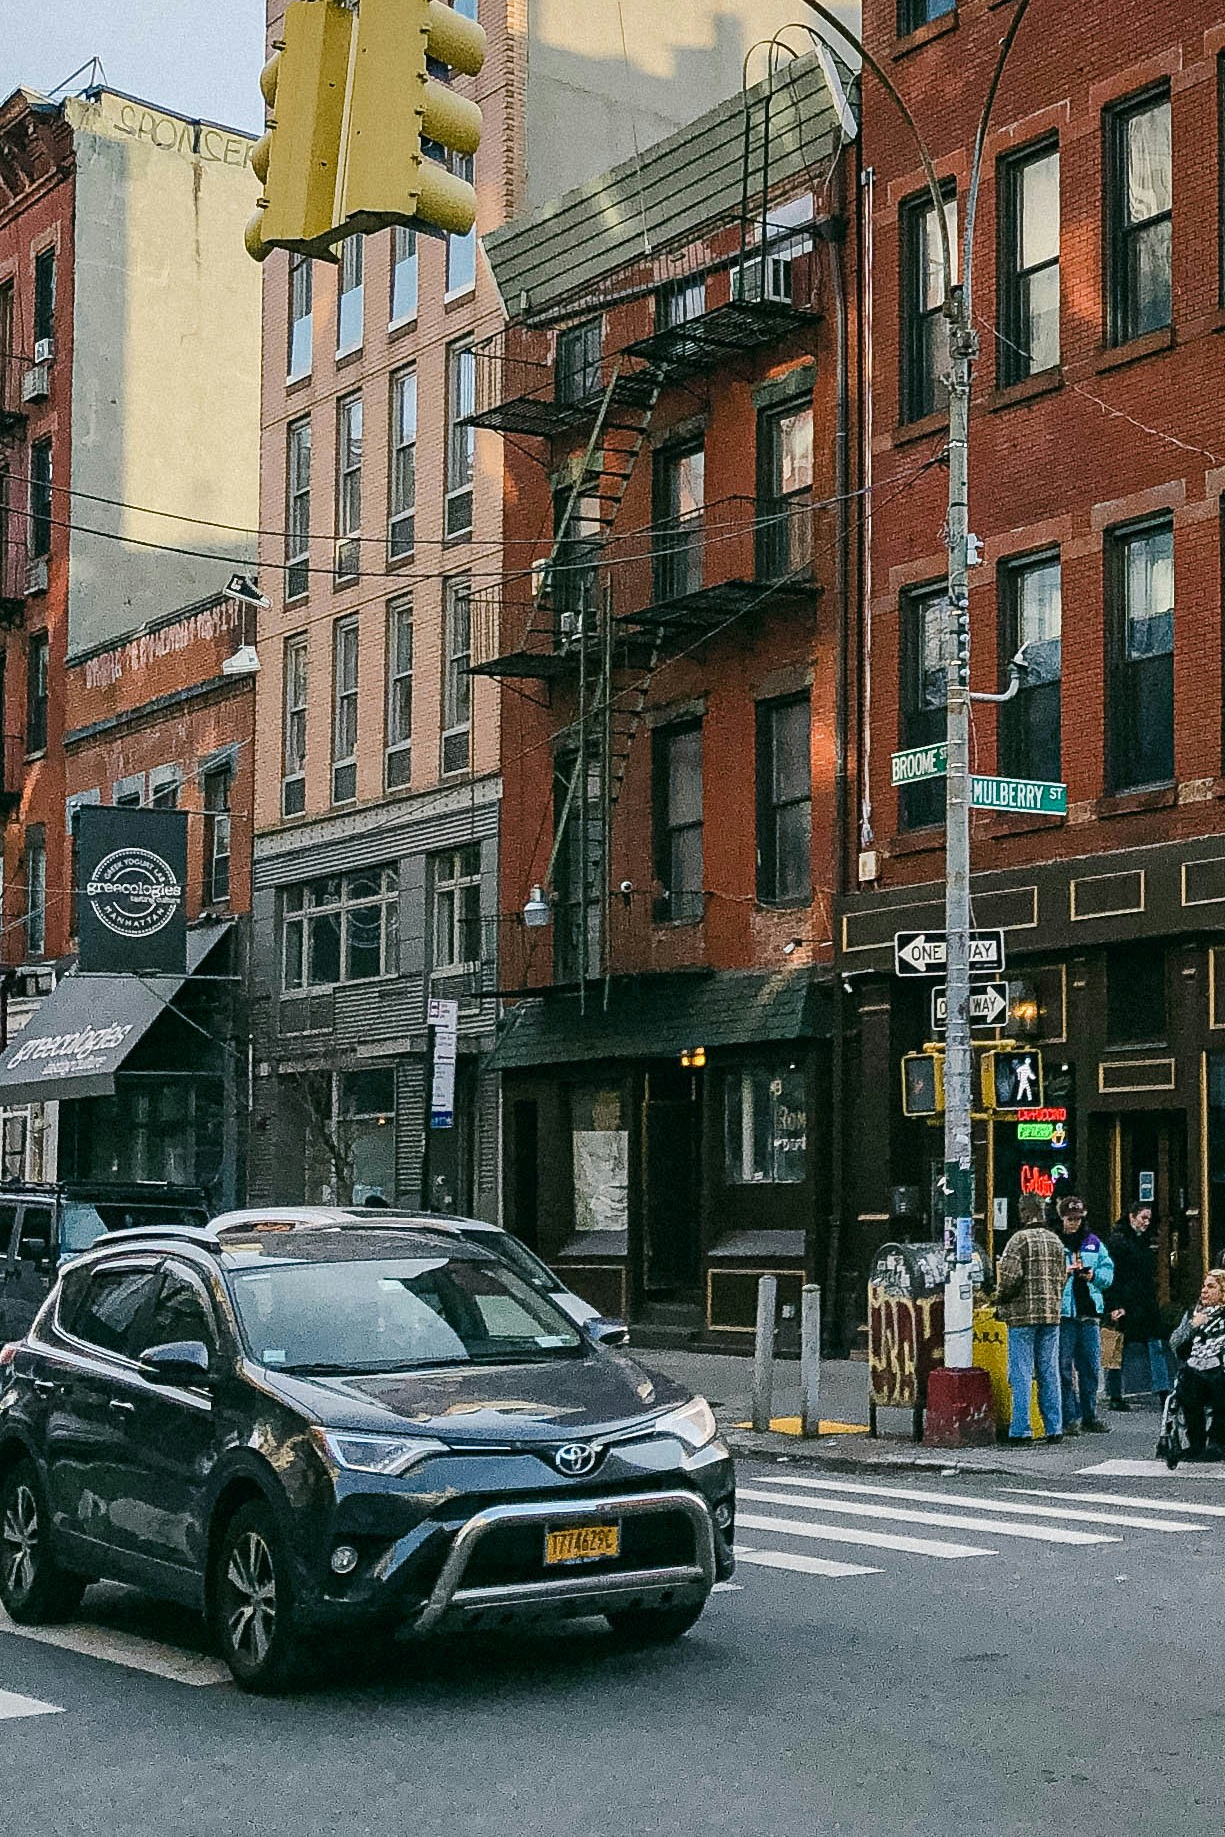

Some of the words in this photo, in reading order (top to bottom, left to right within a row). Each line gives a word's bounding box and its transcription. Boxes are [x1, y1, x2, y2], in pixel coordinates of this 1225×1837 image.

[892, 749, 938, 782] BROOME
[973, 779, 1044, 809] MULBERRY
[1049, 787, 1063, 800] ST
[86, 881, 182, 898] greecologies
[103, 905, 165, 928] MANHATTAN
[911, 945, 943, 961] ONE
[968, 942, 993, 961] AY
[973, 996, 998, 1013] WAY
